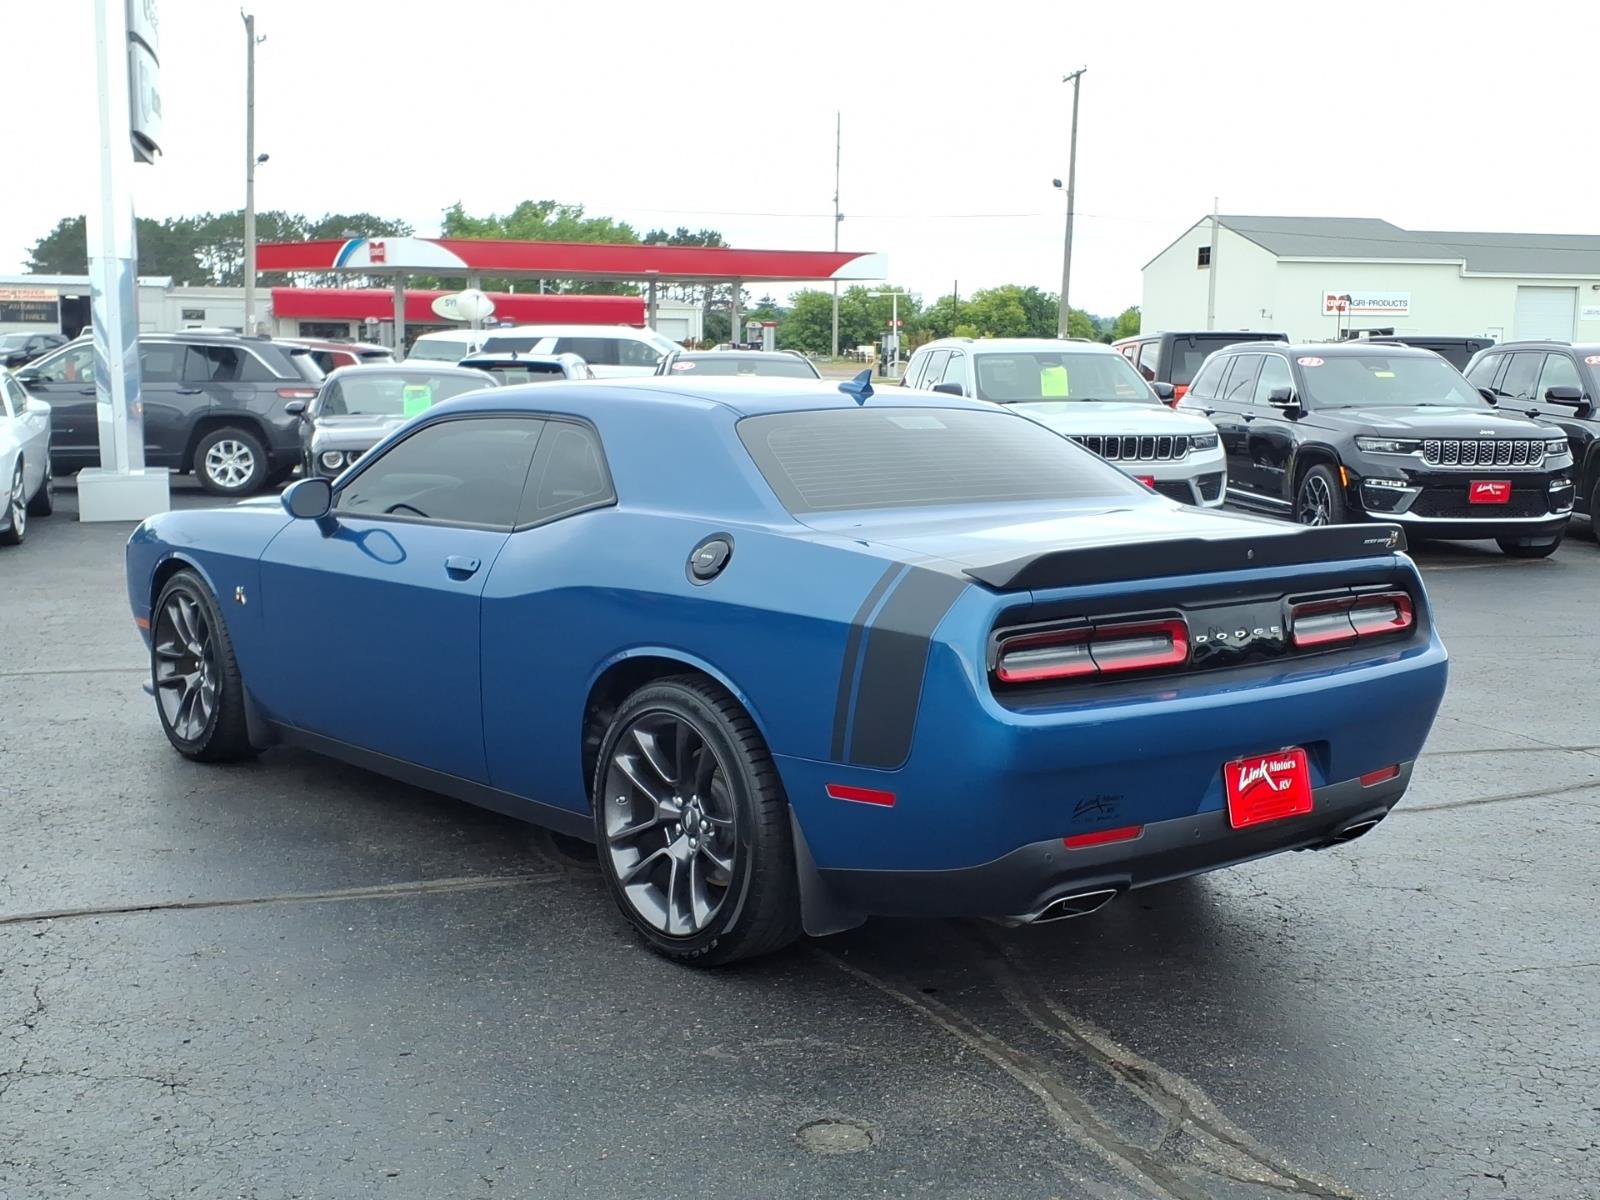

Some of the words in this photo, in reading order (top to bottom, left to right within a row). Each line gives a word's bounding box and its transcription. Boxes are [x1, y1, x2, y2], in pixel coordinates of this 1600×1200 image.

[1195, 626, 1280, 643] DODGE
[1238, 759, 1279, 792] Link
[1269, 760, 1296, 772] Motors
[1279, 778, 1292, 790] RV
